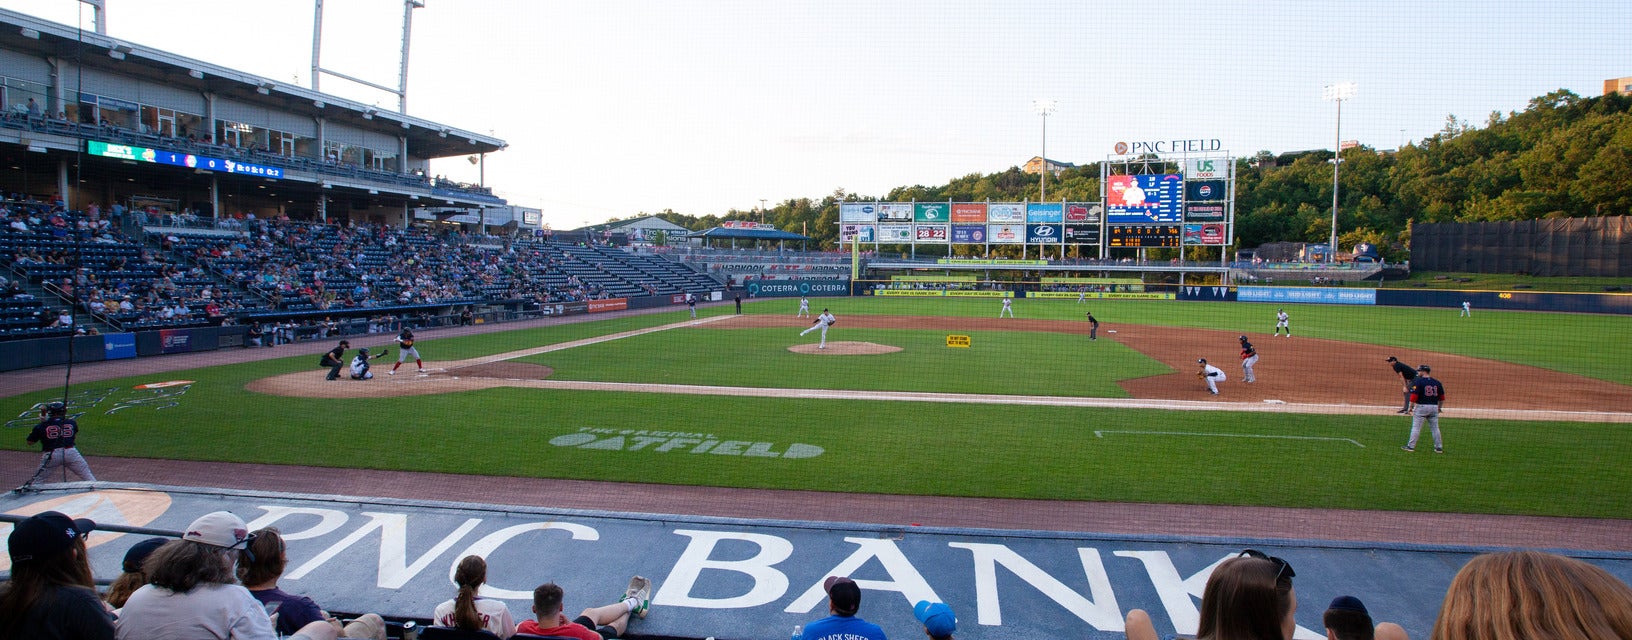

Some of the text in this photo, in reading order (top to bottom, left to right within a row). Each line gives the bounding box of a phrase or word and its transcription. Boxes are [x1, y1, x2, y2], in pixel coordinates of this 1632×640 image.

[1132, 139, 1220, 153] PNC FIELD
[170, 154, 176, 162] 1
[1028, 209, 1060, 218] Geisinger
[1425, 385, 1438, 396] 81
[620, 430, 718, 439] ORIGINAL
[548, 432, 824, 459] OATFIELD
[246, 506, 600, 600] PNC
